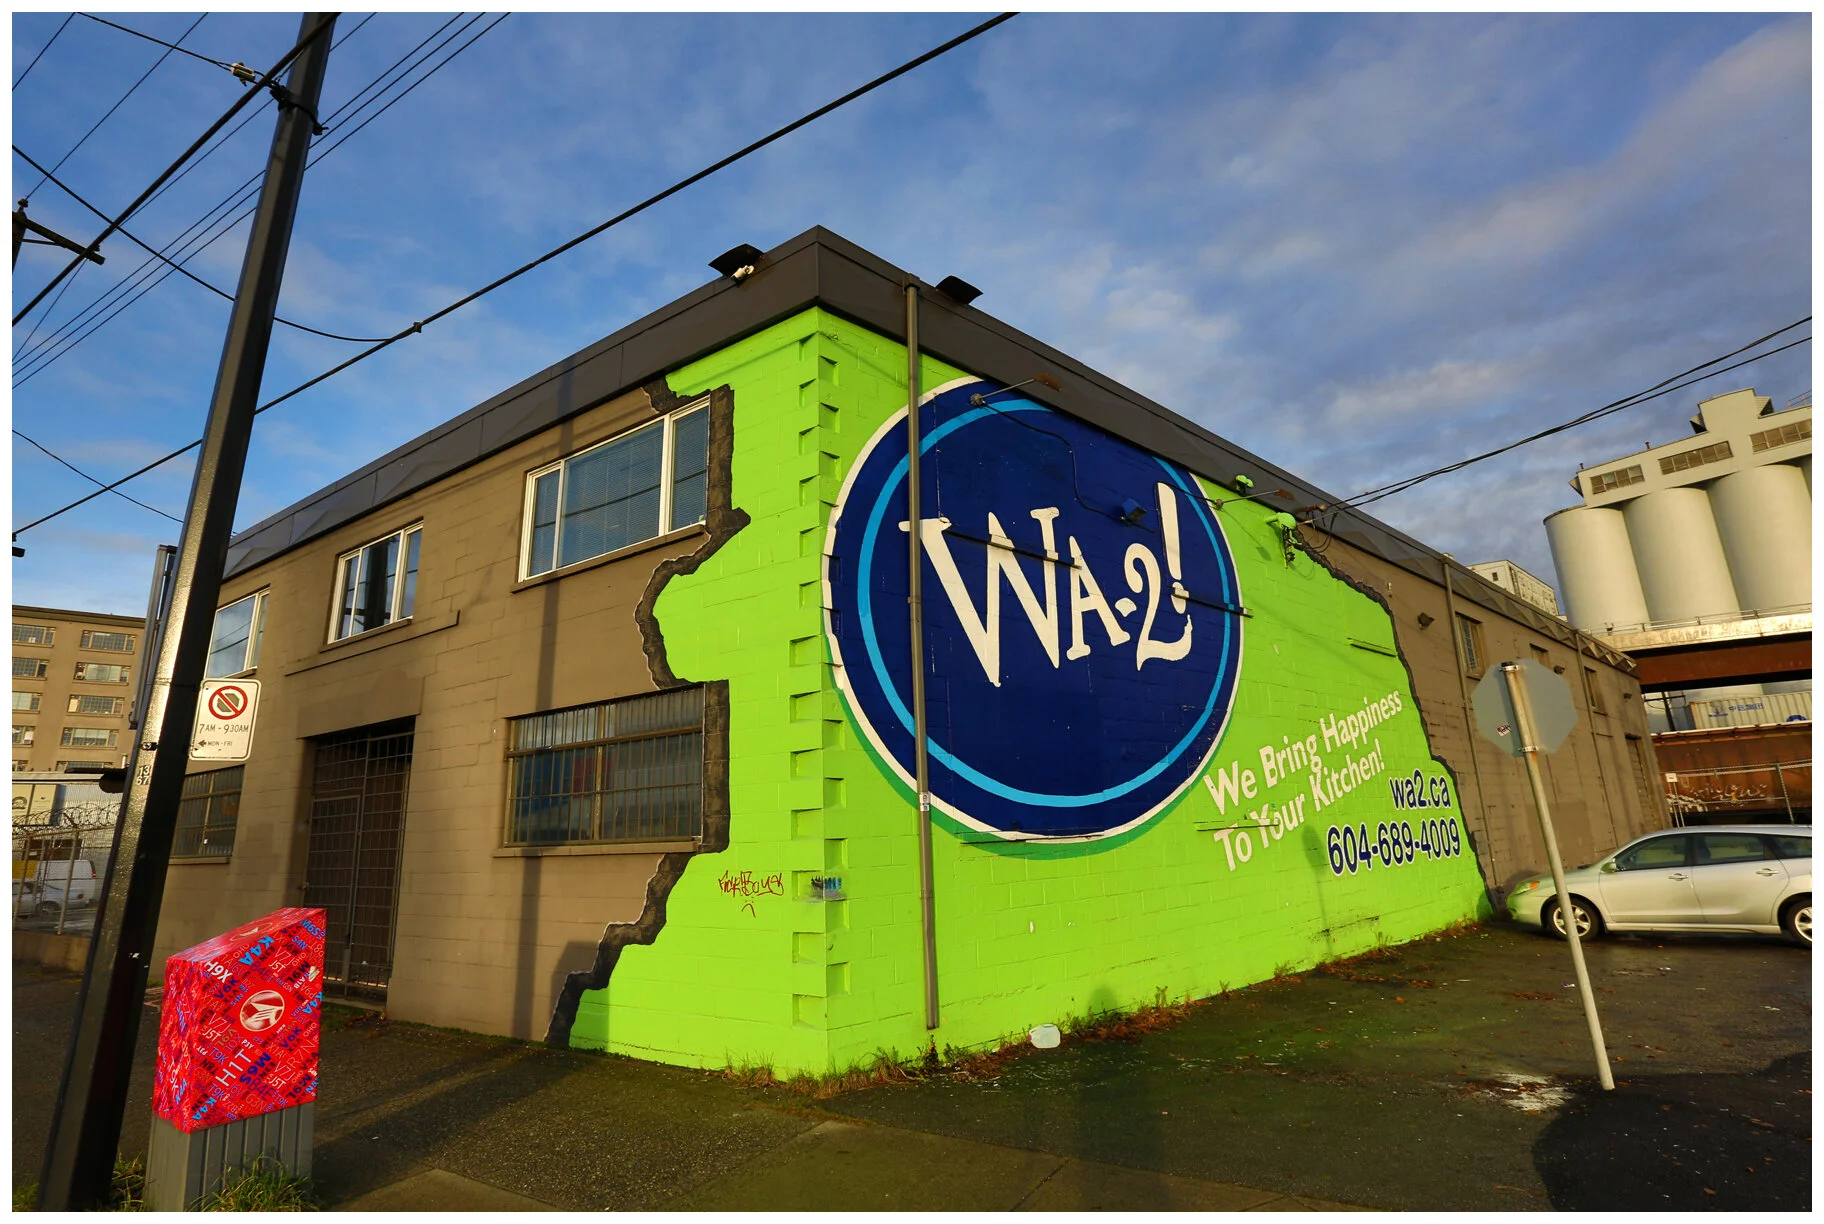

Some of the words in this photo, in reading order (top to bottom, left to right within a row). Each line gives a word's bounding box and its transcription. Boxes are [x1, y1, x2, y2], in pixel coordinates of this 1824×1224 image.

[898, 482, 1193, 687] WA-2!
[199, 724, 216, 734] 7AM
[1204, 761, 1258, 815] We
[1260, 736, 1322, 788] Bring
[1320, 690, 1402, 753] Happiness
[136, 776, 150, 786] 67
[138, 766, 150, 776] 13
[1389, 768, 1451, 811] wa2.ca
[1214, 824, 1252, 872] To
[1250, 794, 1305, 849] Your
[1308, 738, 1385, 812] Kitchen!
[1327, 817, 1461, 876] 604-689-4009
[238, 936, 274, 966] K4A
[204, 960, 233, 983] H9X
[269, 960, 286, 972] J5T
[214, 976, 240, 998] V6K
[208, 1012, 232, 1034] V7J
[202, 1028, 222, 1042] J5T
[280, 1026, 302, 1048] V6K
[209, 1046, 228, 1066] T9K
[286, 1040, 316, 1068] R7N
[214, 1048, 252, 1086] H1T
[239, 1052, 272, 1084] M6S
[274, 1060, 296, 1082] V7J
[208, 1082, 226, 1100] T9K
[268, 1076, 286, 1090] J5T
[191, 1097, 217, 1120] K4A
